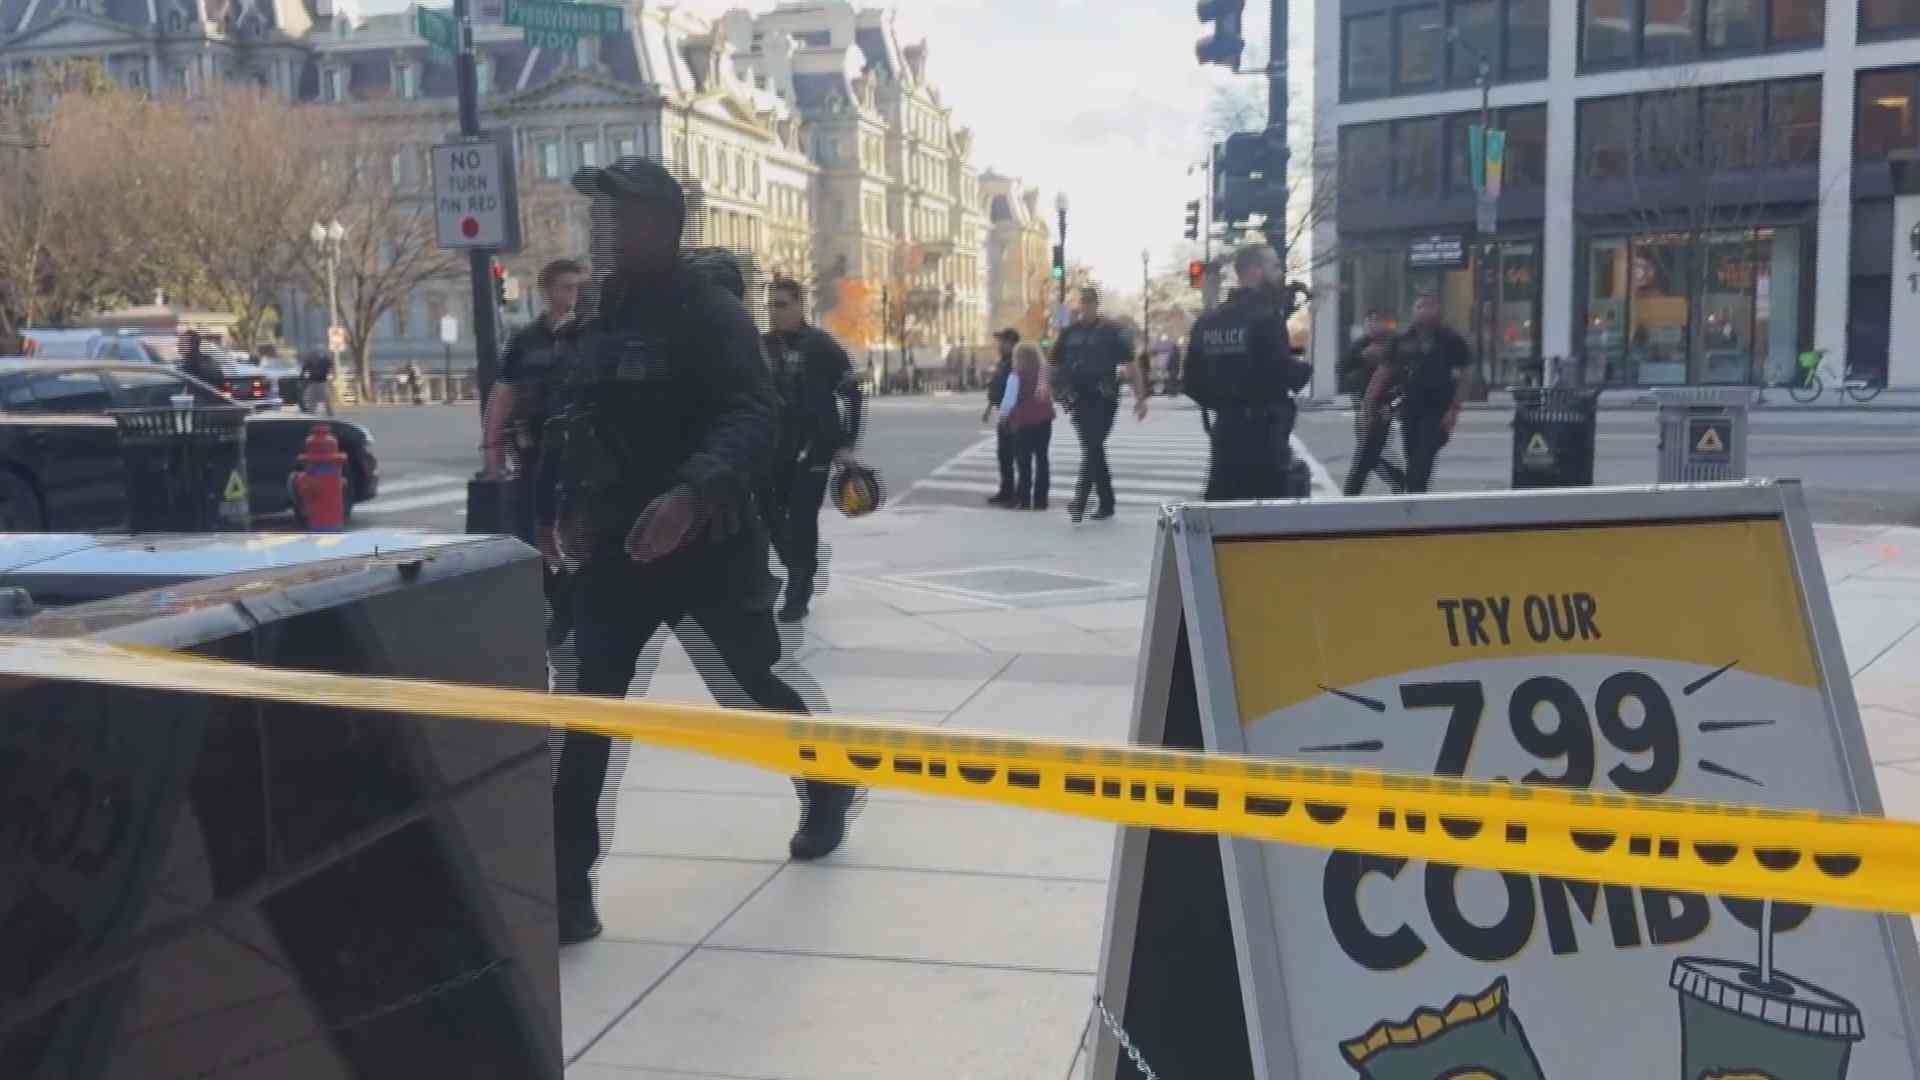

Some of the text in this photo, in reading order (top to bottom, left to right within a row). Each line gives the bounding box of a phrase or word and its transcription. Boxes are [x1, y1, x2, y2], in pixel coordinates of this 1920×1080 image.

[528, 31, 573, 49] 1700
[450, 151, 480, 171] NO
[448, 175, 487, 192] TURN
[467, 195, 497, 212] RED
[1202, 327, 1247, 345] POLICE
[1437, 592, 1601, 647] TRY OUR
[1400, 671, 1680, 796] 799
[1322, 847, 1814, 972] COMB
